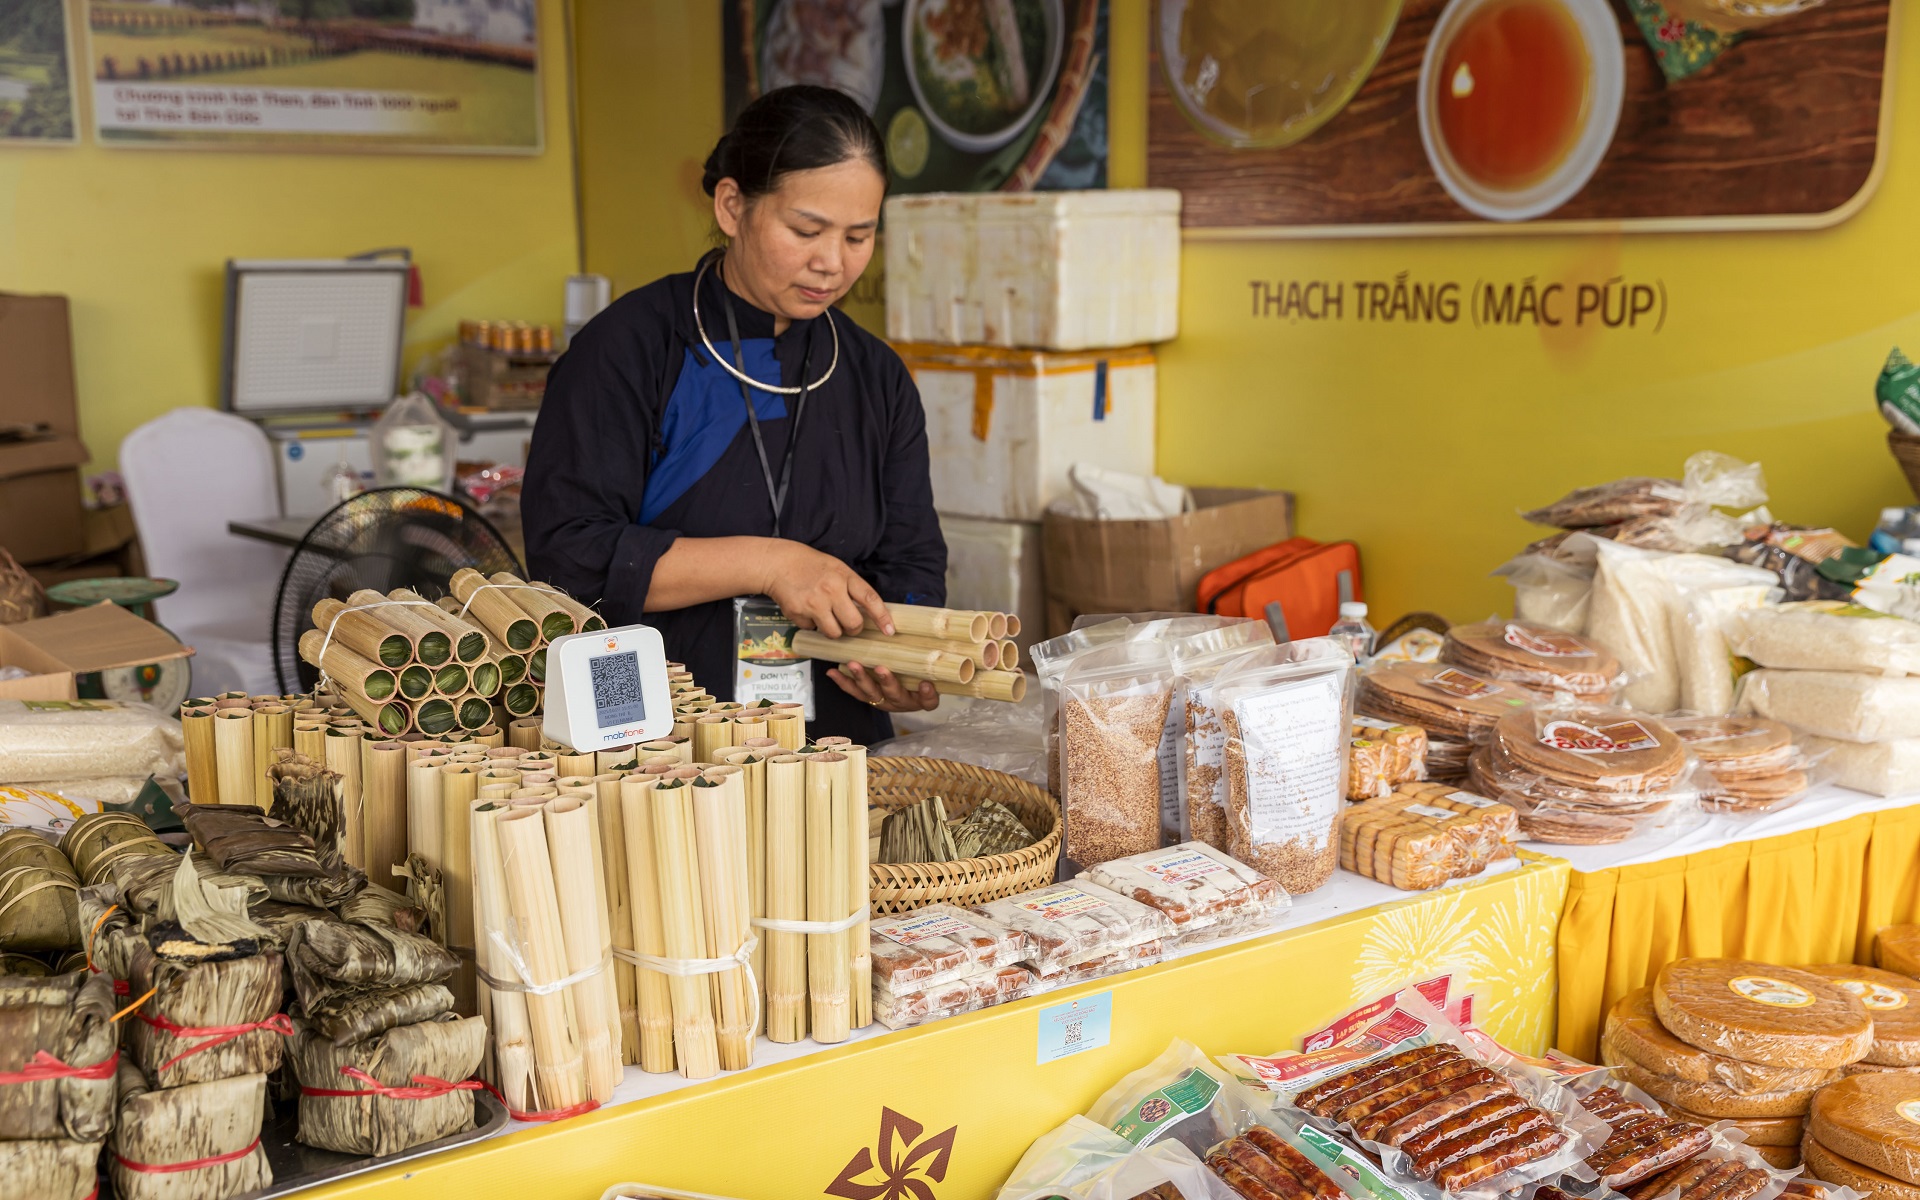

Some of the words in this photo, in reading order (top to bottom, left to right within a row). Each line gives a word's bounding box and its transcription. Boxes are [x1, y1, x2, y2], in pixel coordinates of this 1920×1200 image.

[1249, 280, 1344, 325] THẠCH
[1353, 270, 1460, 324] TRẮNG
[1576, 275, 1668, 335] PÚP)
[603, 728, 645, 742] mobifone
